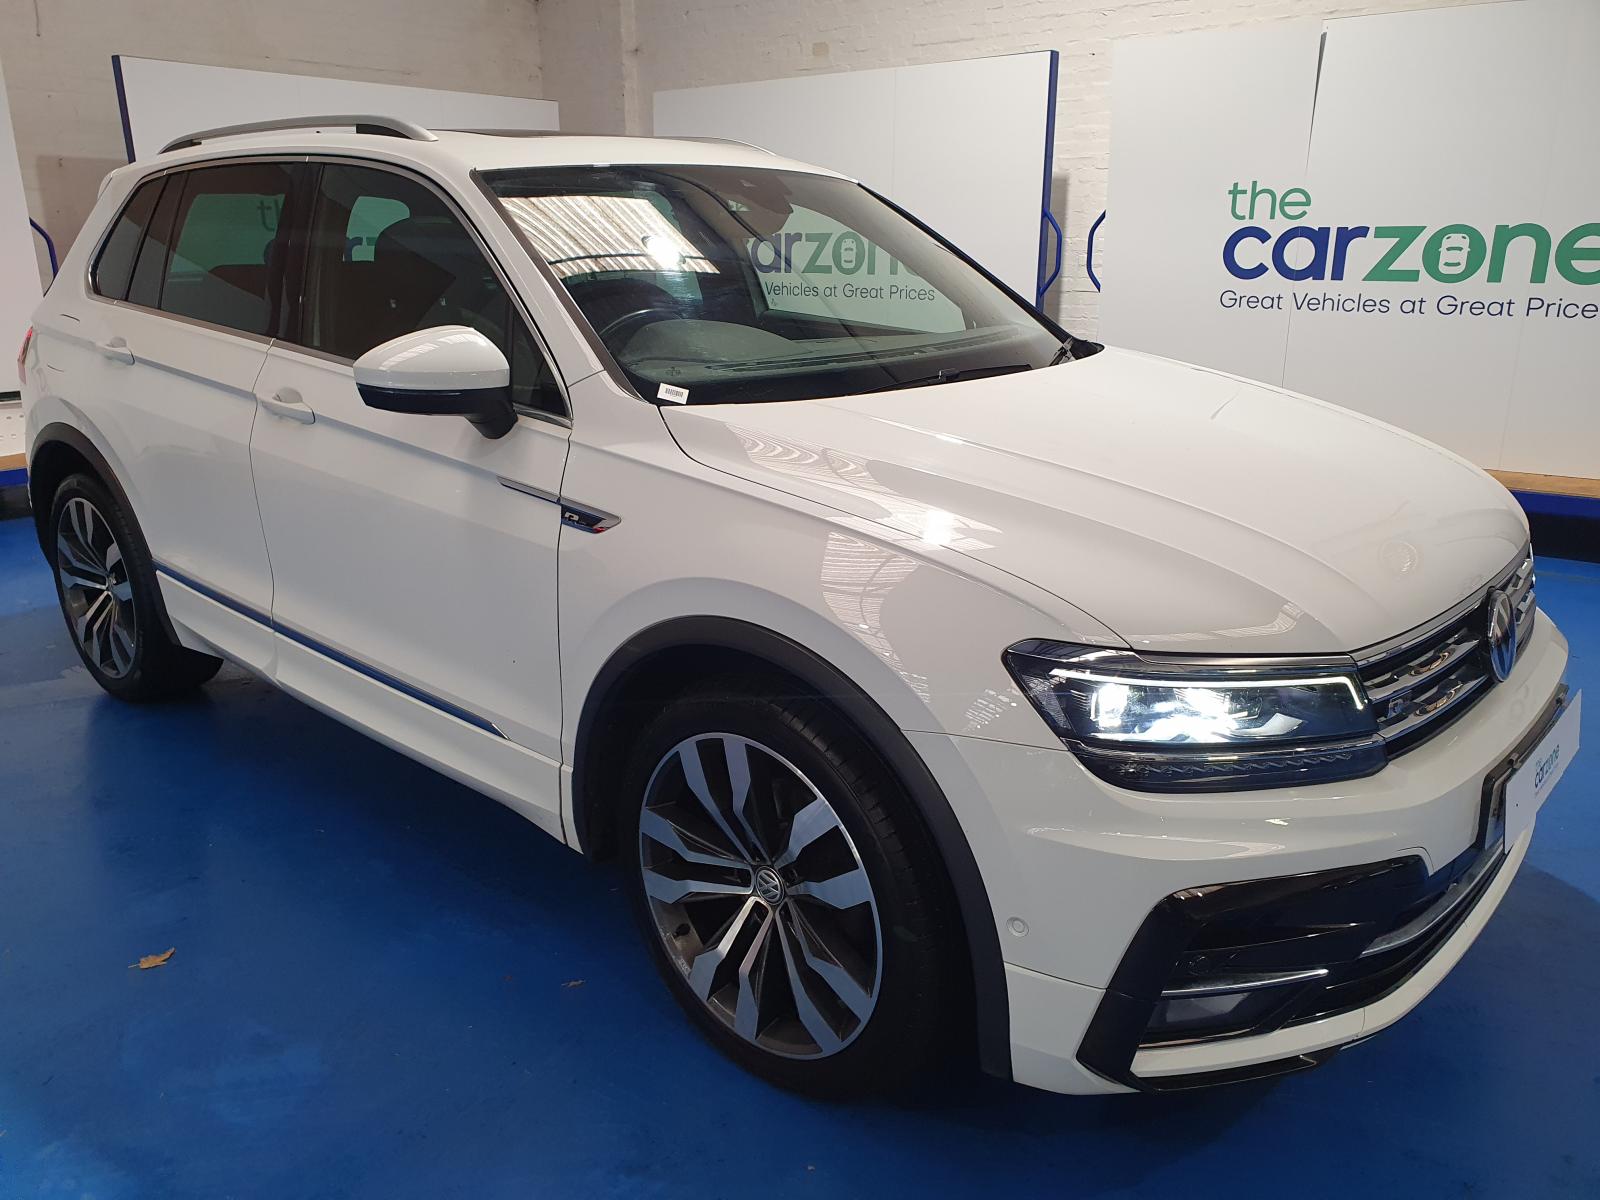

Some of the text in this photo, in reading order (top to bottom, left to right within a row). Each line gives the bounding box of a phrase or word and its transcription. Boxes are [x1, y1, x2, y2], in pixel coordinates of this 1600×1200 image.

[1228, 180, 1312, 221] the
[1222, 222, 1600, 286] carzone
[765, 281, 936, 301] Vehicles at Great Prices
[1219, 289, 1284, 311] Great
[1292, 291, 1391, 314] Vehicles
[1399, 297, 1426, 316] at
[1436, 294, 1515, 317] Great
